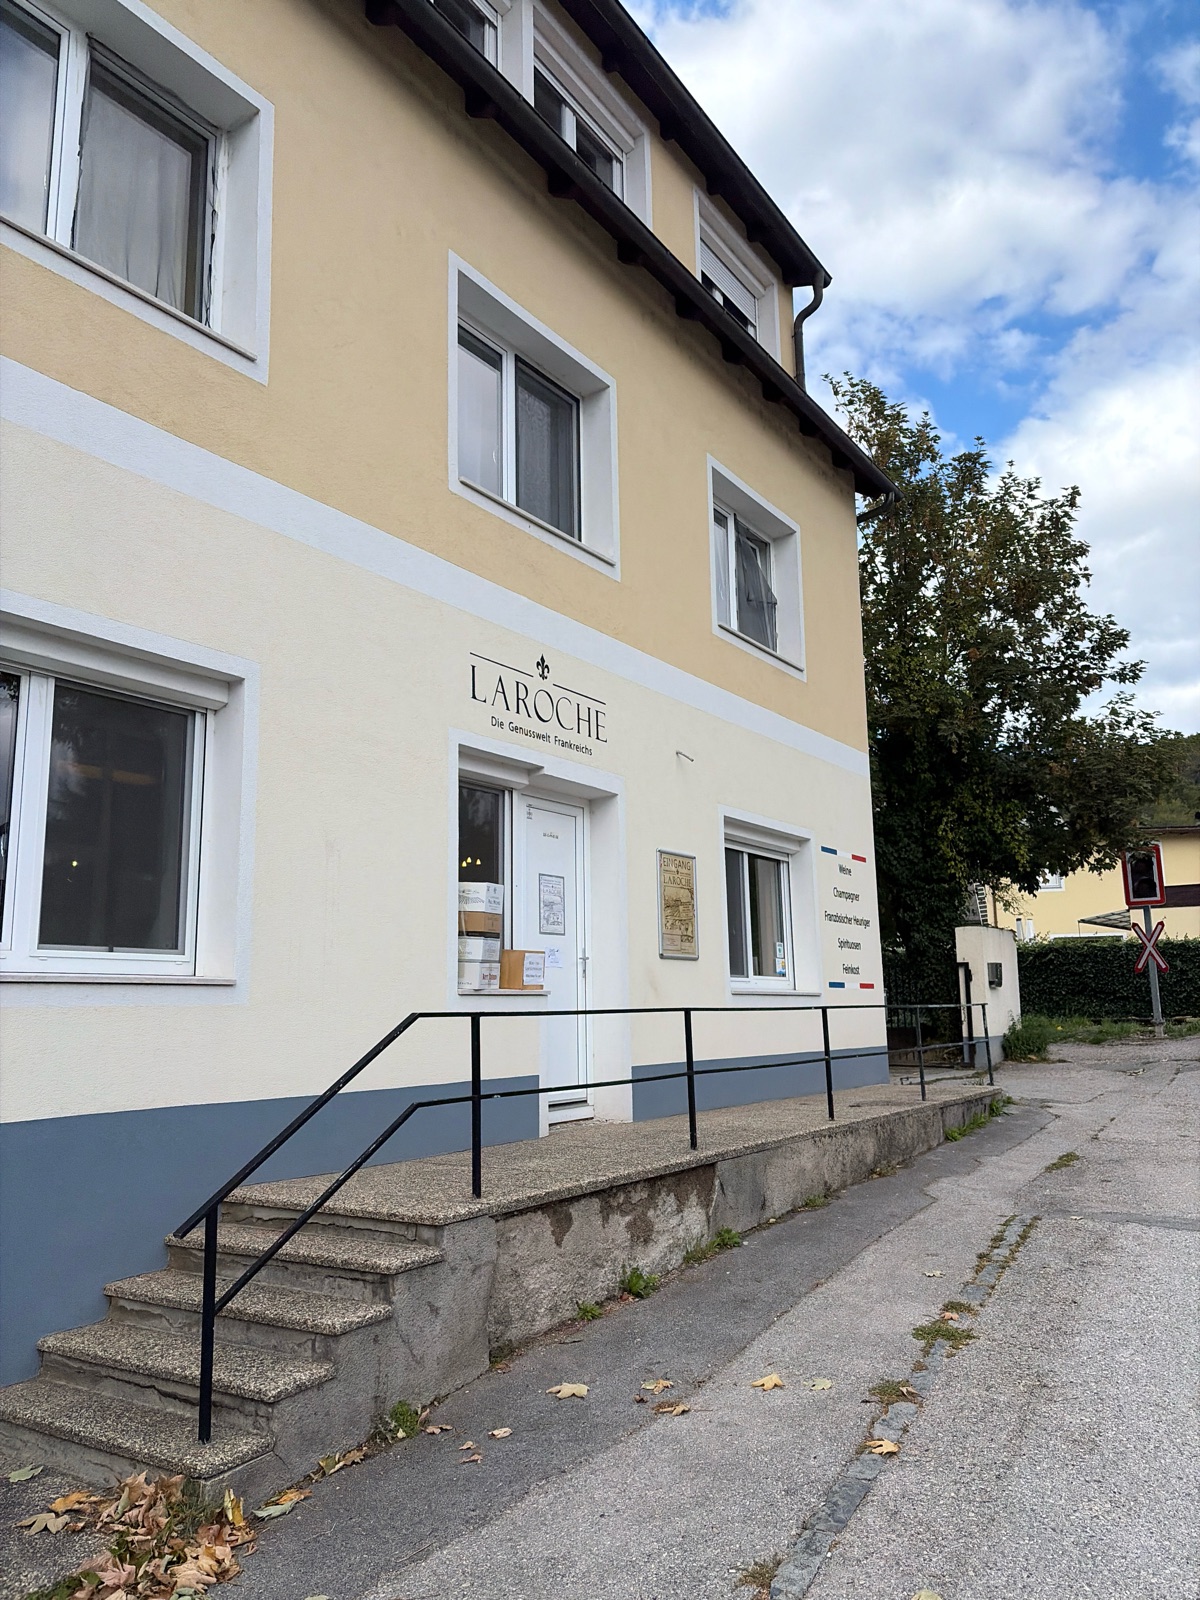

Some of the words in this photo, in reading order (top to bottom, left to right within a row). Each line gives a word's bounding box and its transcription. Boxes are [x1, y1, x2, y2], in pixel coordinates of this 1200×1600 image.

[470, 664, 607, 743] LAROCHE
[491, 715, 504, 729] Die
[508, 721, 551, 744] Genusswelt
[554, 735, 593, 756] Frankreichs
[663, 856, 691, 871] EINGANG
[838, 863, 852, 876] Weine
[663, 874, 692, 887] LAROCHE
[833, 886, 860, 903] Champagner
[824, 910, 853, 926] Französischer
[853, 916, 871, 929] Heuriger
[837, 937, 862, 951] Spirituosen
[842, 963, 860, 975] Feinkost
